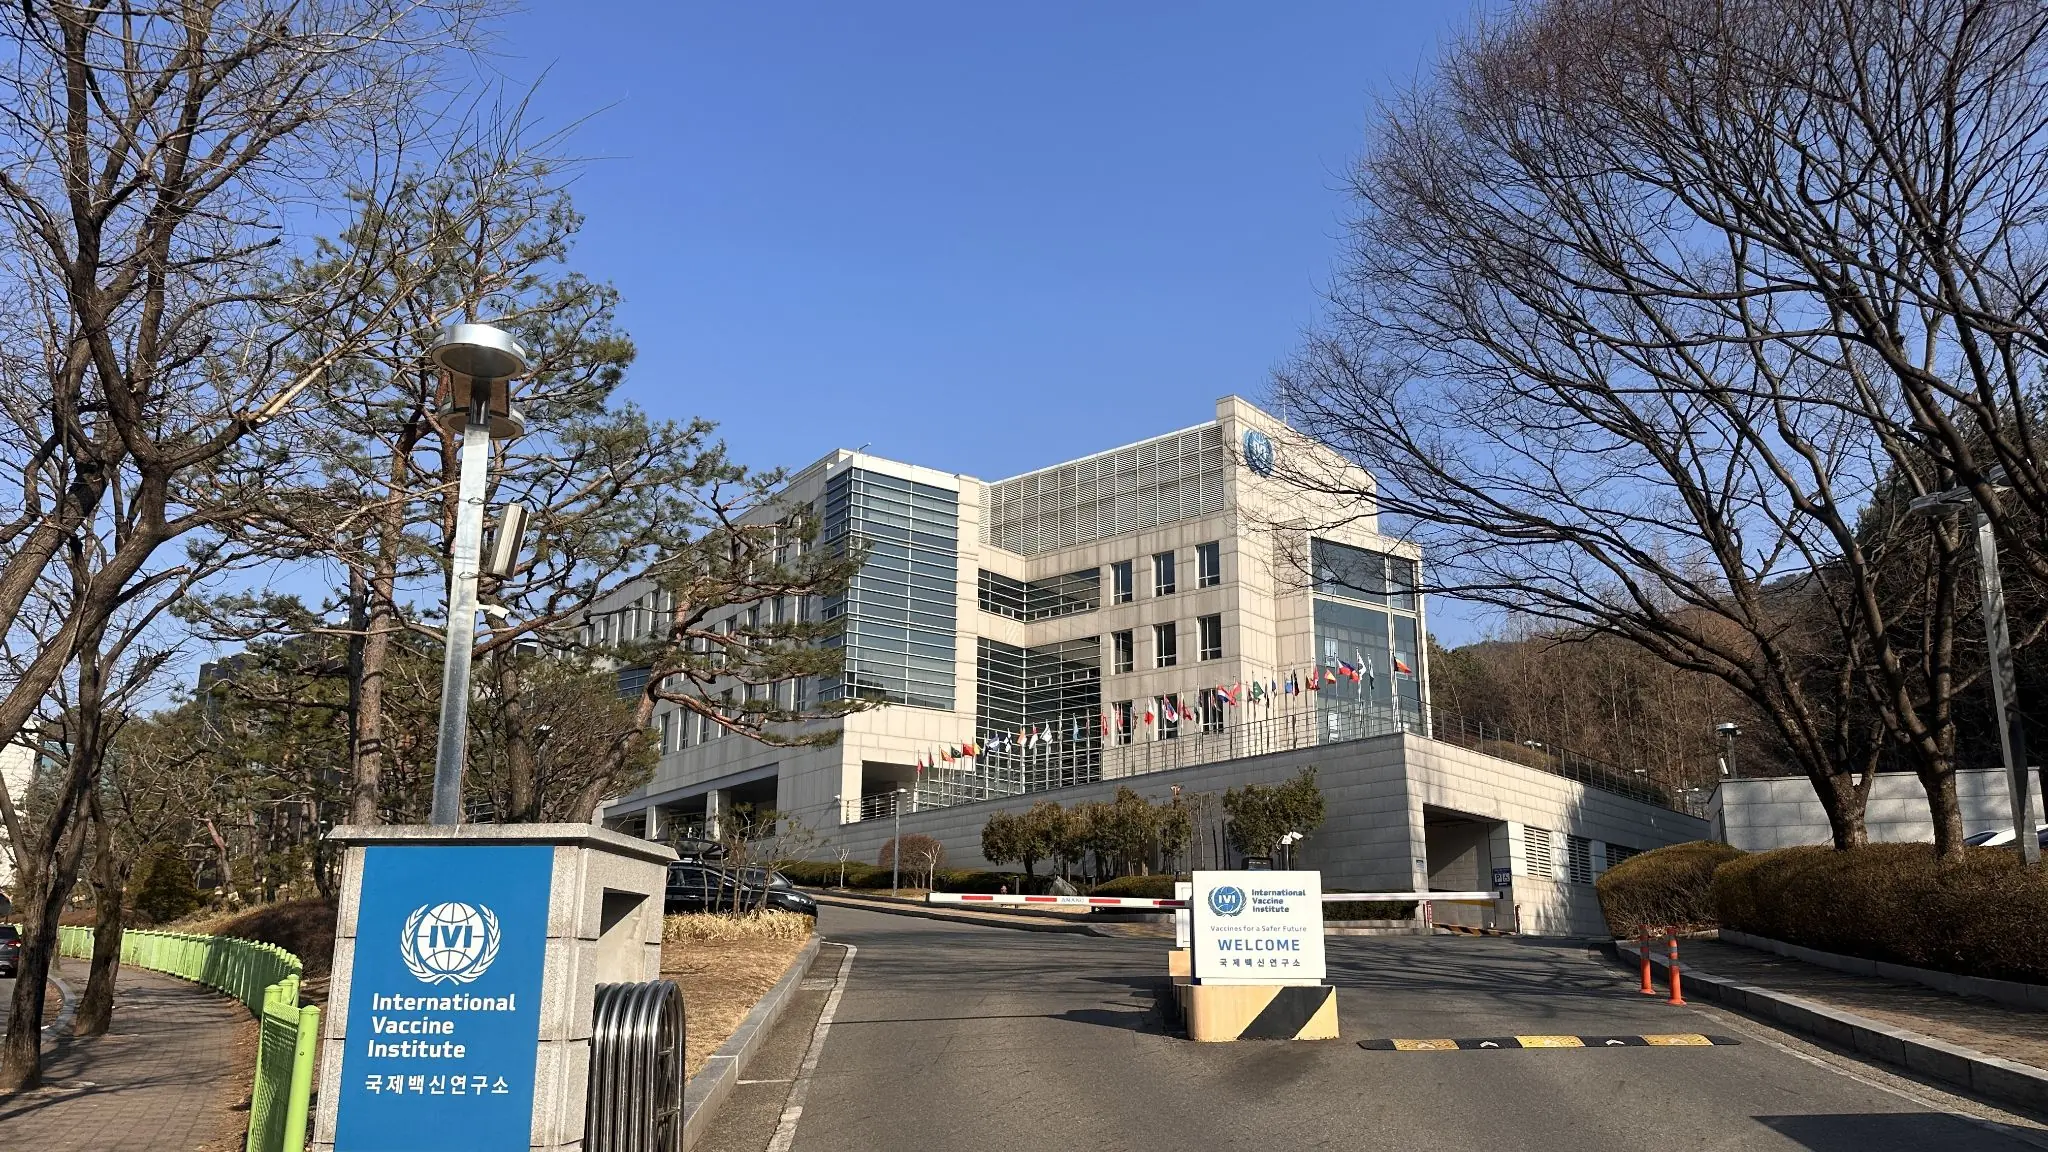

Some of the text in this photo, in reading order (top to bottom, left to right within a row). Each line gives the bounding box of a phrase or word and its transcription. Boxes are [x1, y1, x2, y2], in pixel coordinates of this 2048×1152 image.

[1218, 894, 1236, 904] IVI
[1252, 897, 1284, 905] Vaccine
[1252, 905, 1290, 913] Institute
[428, 925, 473, 948] IVI
[1217, 939, 1300, 951] WELCOME
[1219, 958, 1300, 968] 국제백신연구소
[372, 992, 516, 1011] International
[371, 1016, 455, 1034] Vaccine
[367, 1039, 466, 1058] Institute
[365, 1074, 509, 1095] 국제백신연구소
